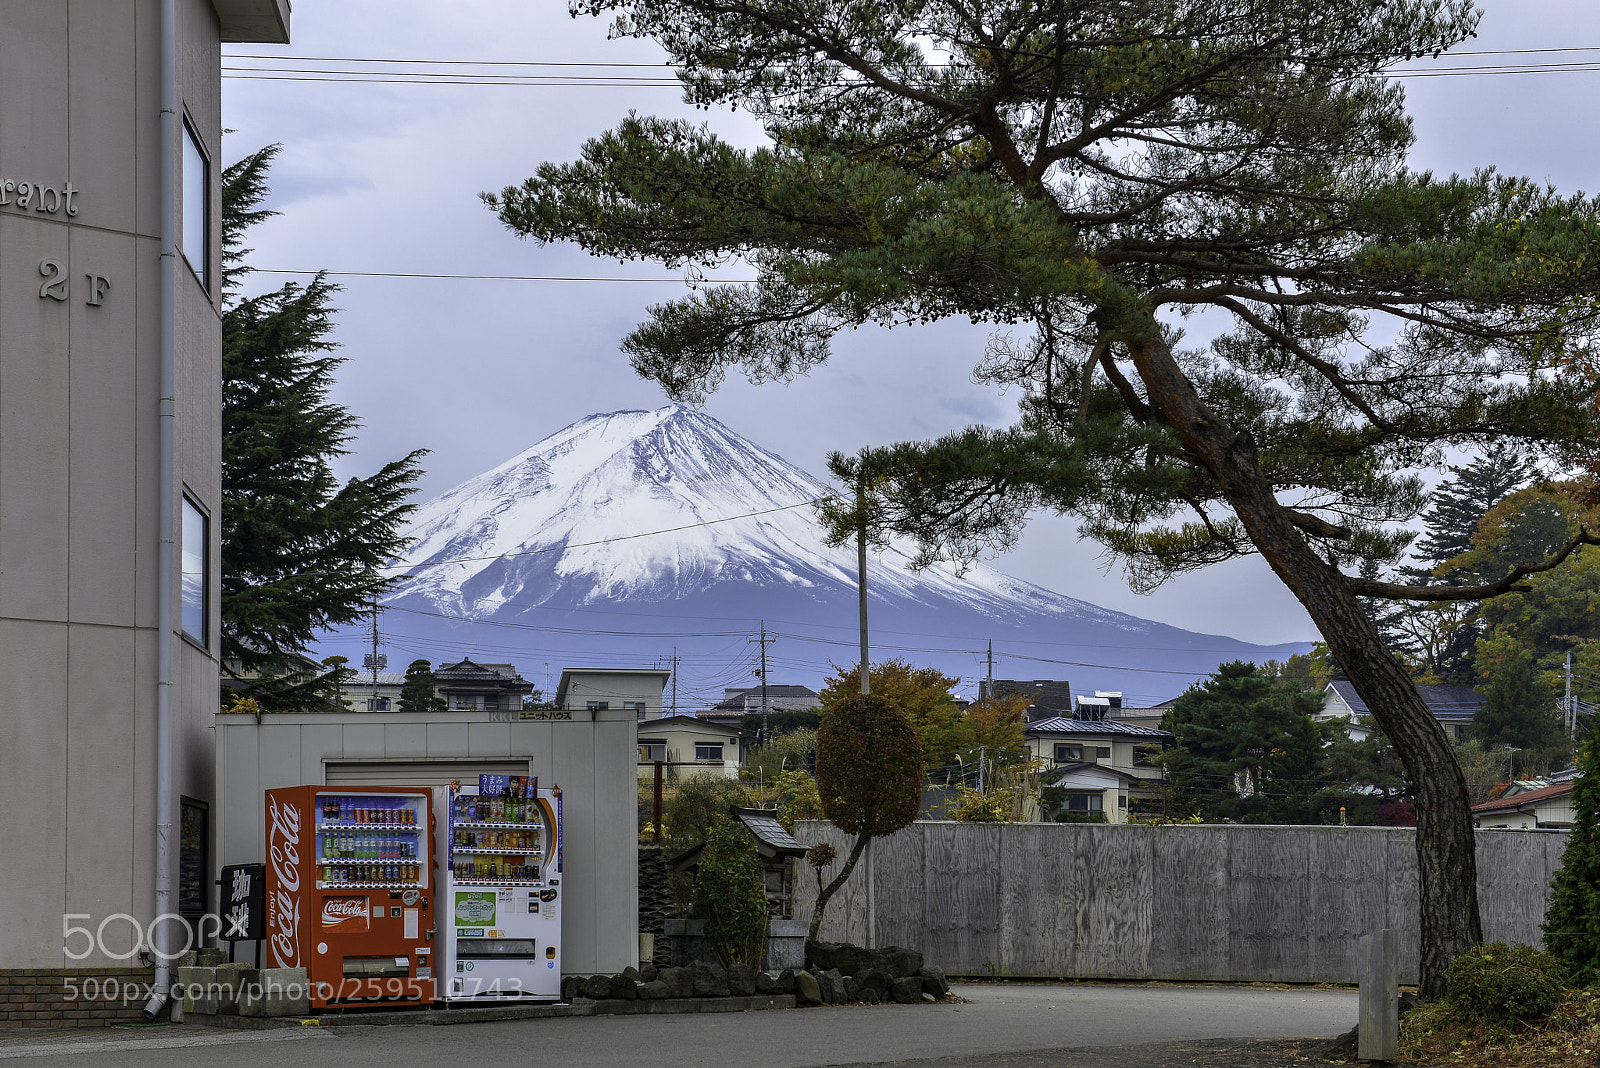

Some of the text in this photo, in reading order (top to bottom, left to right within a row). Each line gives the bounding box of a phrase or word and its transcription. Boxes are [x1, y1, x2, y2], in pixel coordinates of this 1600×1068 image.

[520, 711, 571, 720] ユニットハウス
[482, 775, 503, 784] うまみ
[269, 793, 301, 969] Coca-Cola
[268, 891, 276, 928] Enjoy!
[323, 899, 364, 915] Coca-Cola
